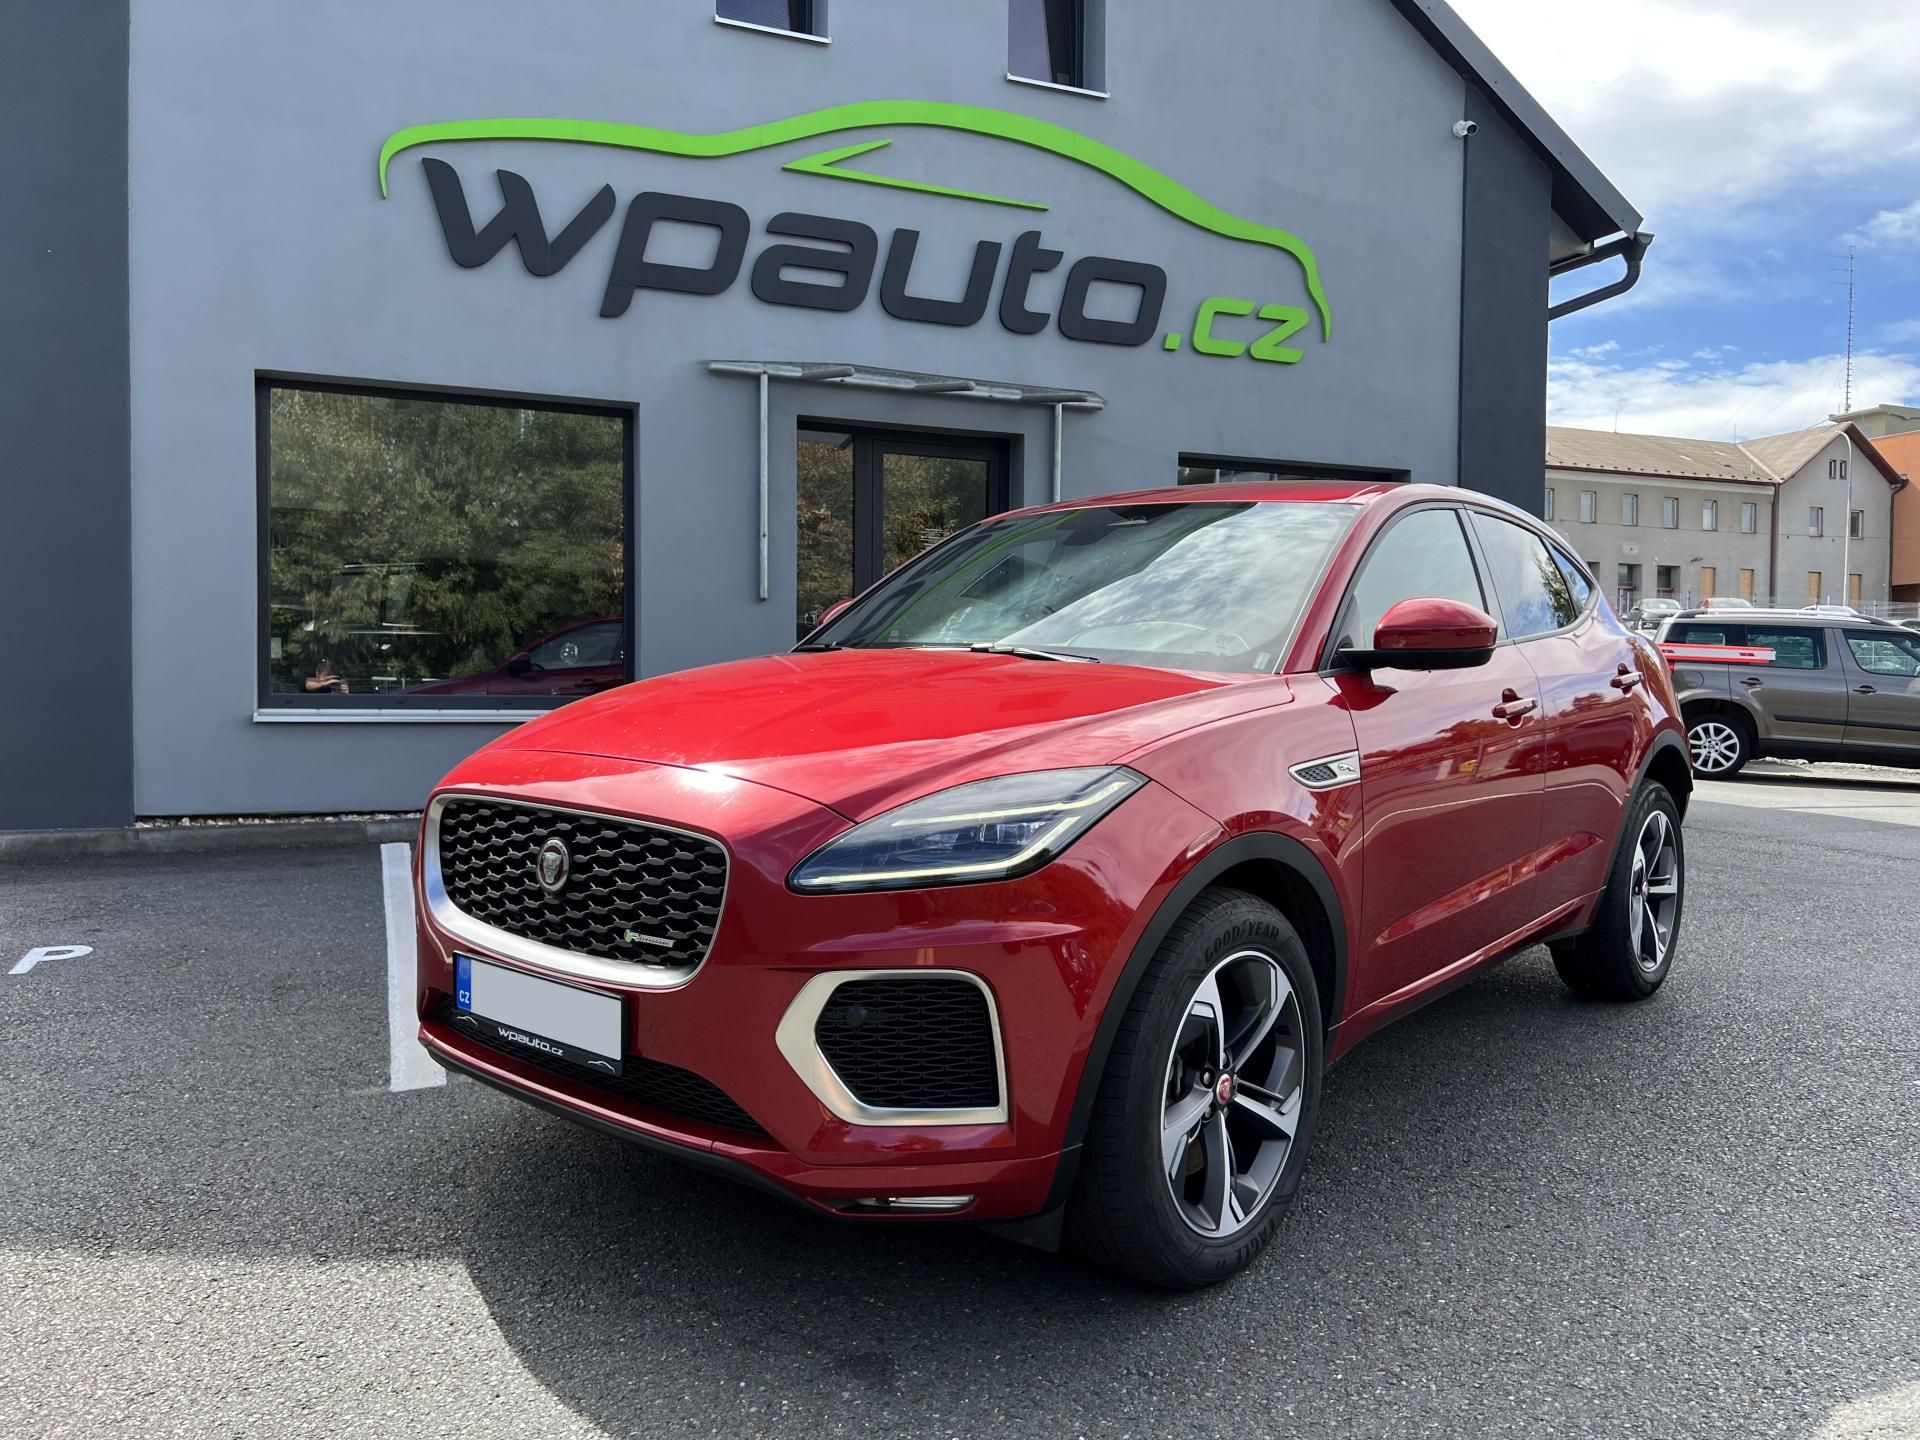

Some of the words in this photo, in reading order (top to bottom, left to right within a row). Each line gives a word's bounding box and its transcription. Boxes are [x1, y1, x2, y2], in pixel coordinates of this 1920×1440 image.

[421, 156, 1311, 364] wpauto.cz
[1204, 918, 1280, 963] GOODYEAR
[8, 944, 94, 975] P
[459, 990, 471, 1004] CZ
[497, 1026, 565, 1056] wpauto.cz
